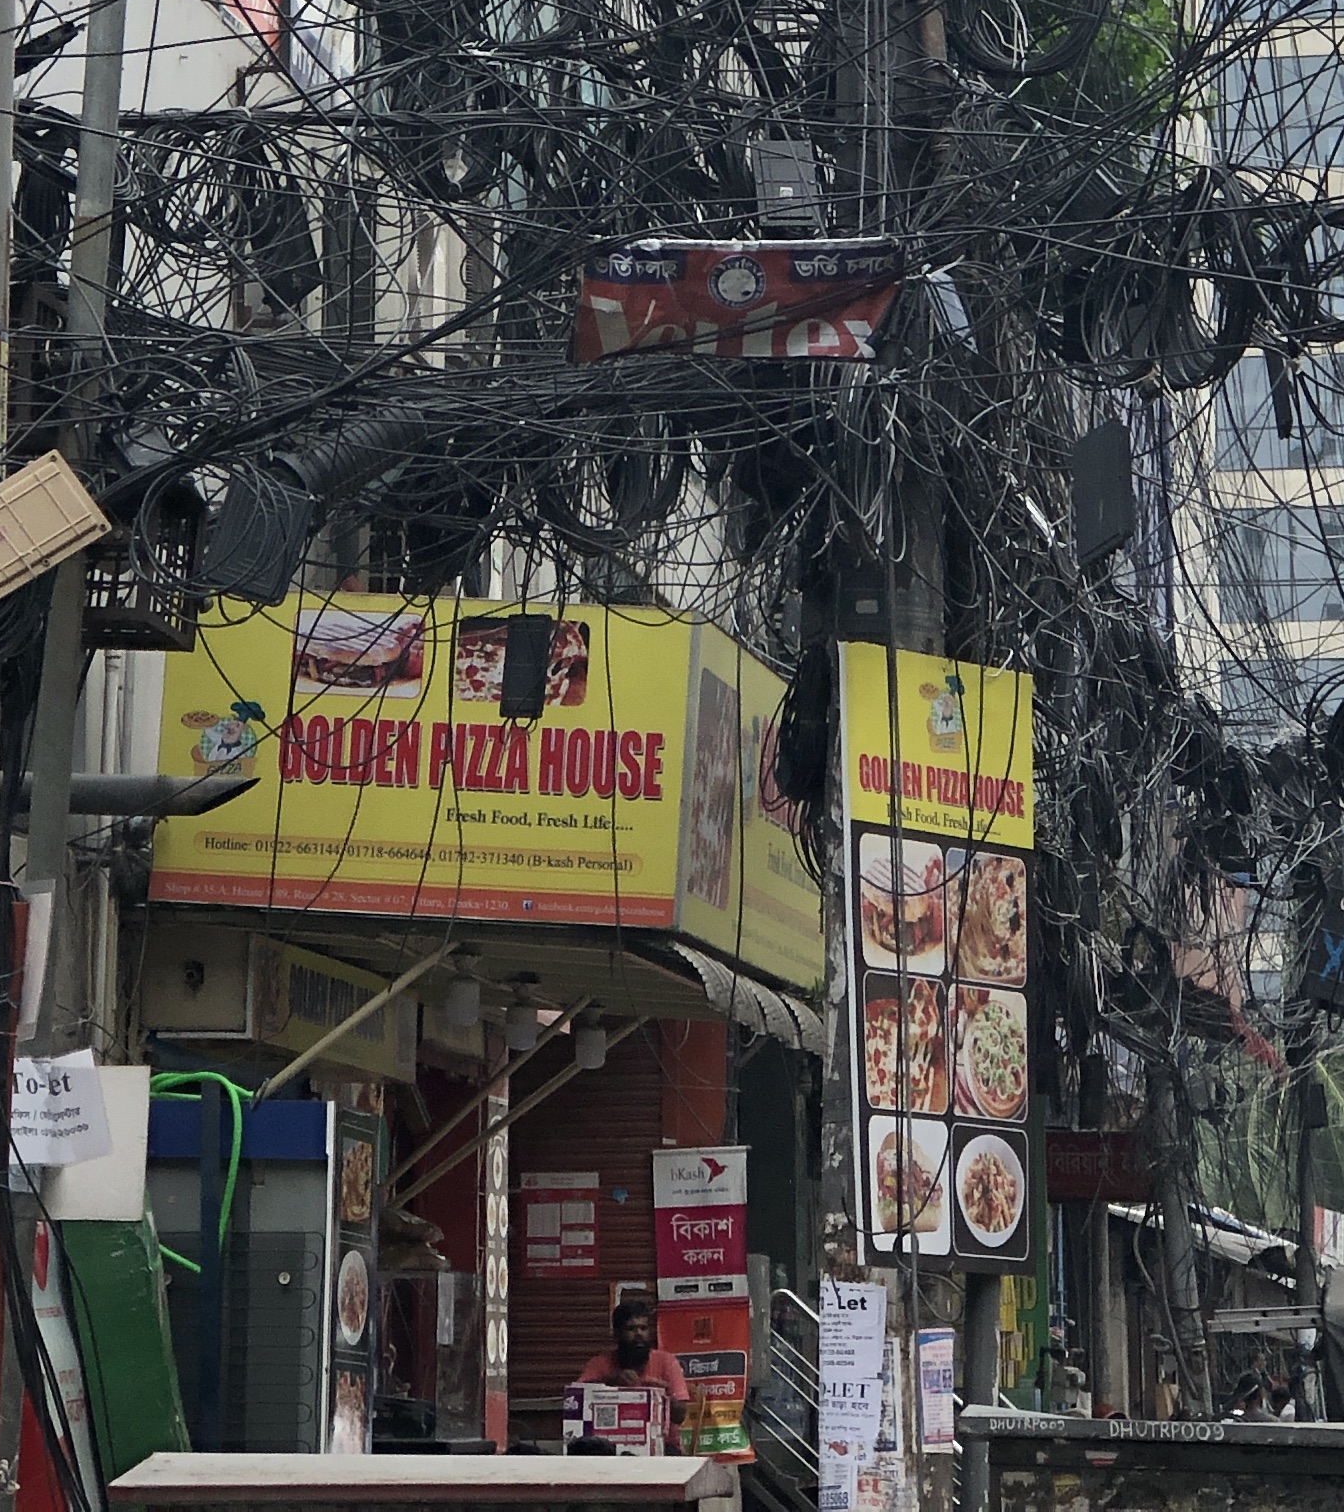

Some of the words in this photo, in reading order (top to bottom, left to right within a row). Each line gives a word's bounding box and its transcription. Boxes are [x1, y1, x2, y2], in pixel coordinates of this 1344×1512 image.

[794, 252, 843, 277] ভর্তি
[279, 713, 421, 788] GOLDEN
[428, 722, 531, 794] PIZZA
[538, 727, 667, 801] HOUSE
[446, 808, 487, 824] Fresh
[491, 810, 532, 828] Food,
[537, 812, 578, 829] Fresh
[205, 837, 252, 852] Hotline:
[670, 1166, 705, 1182] bKash
[670, 1213, 735, 1242] বিকাশ
[682, 1248, 725, 1265] করুন
[837, 1296, 868, 1311] Let
